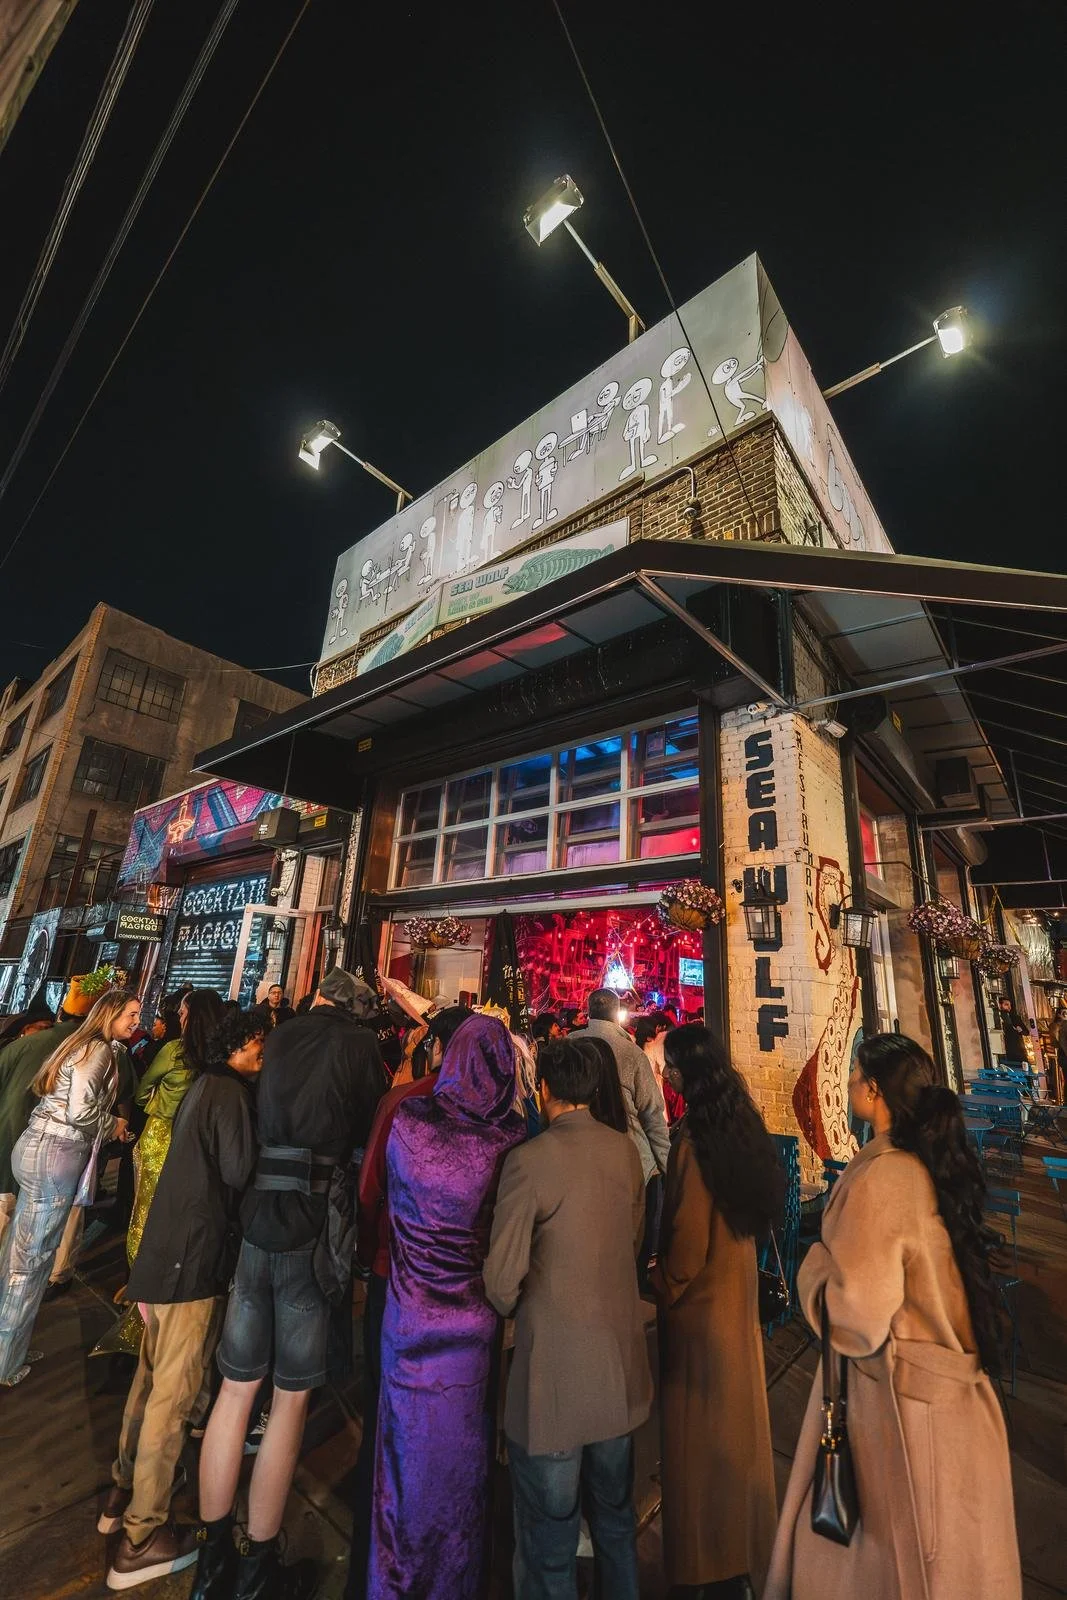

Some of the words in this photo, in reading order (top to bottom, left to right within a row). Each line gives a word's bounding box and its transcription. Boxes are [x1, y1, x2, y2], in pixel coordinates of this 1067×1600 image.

[450, 580, 473, 597] SEA
[475, 567, 509, 588] WOLF
[744, 729, 779, 852] SEA
[795, 731, 815, 931] RESTAURANT
[183, 878, 267, 916] COCKTAIL
[120, 914, 163, 925] COCKTAIL
